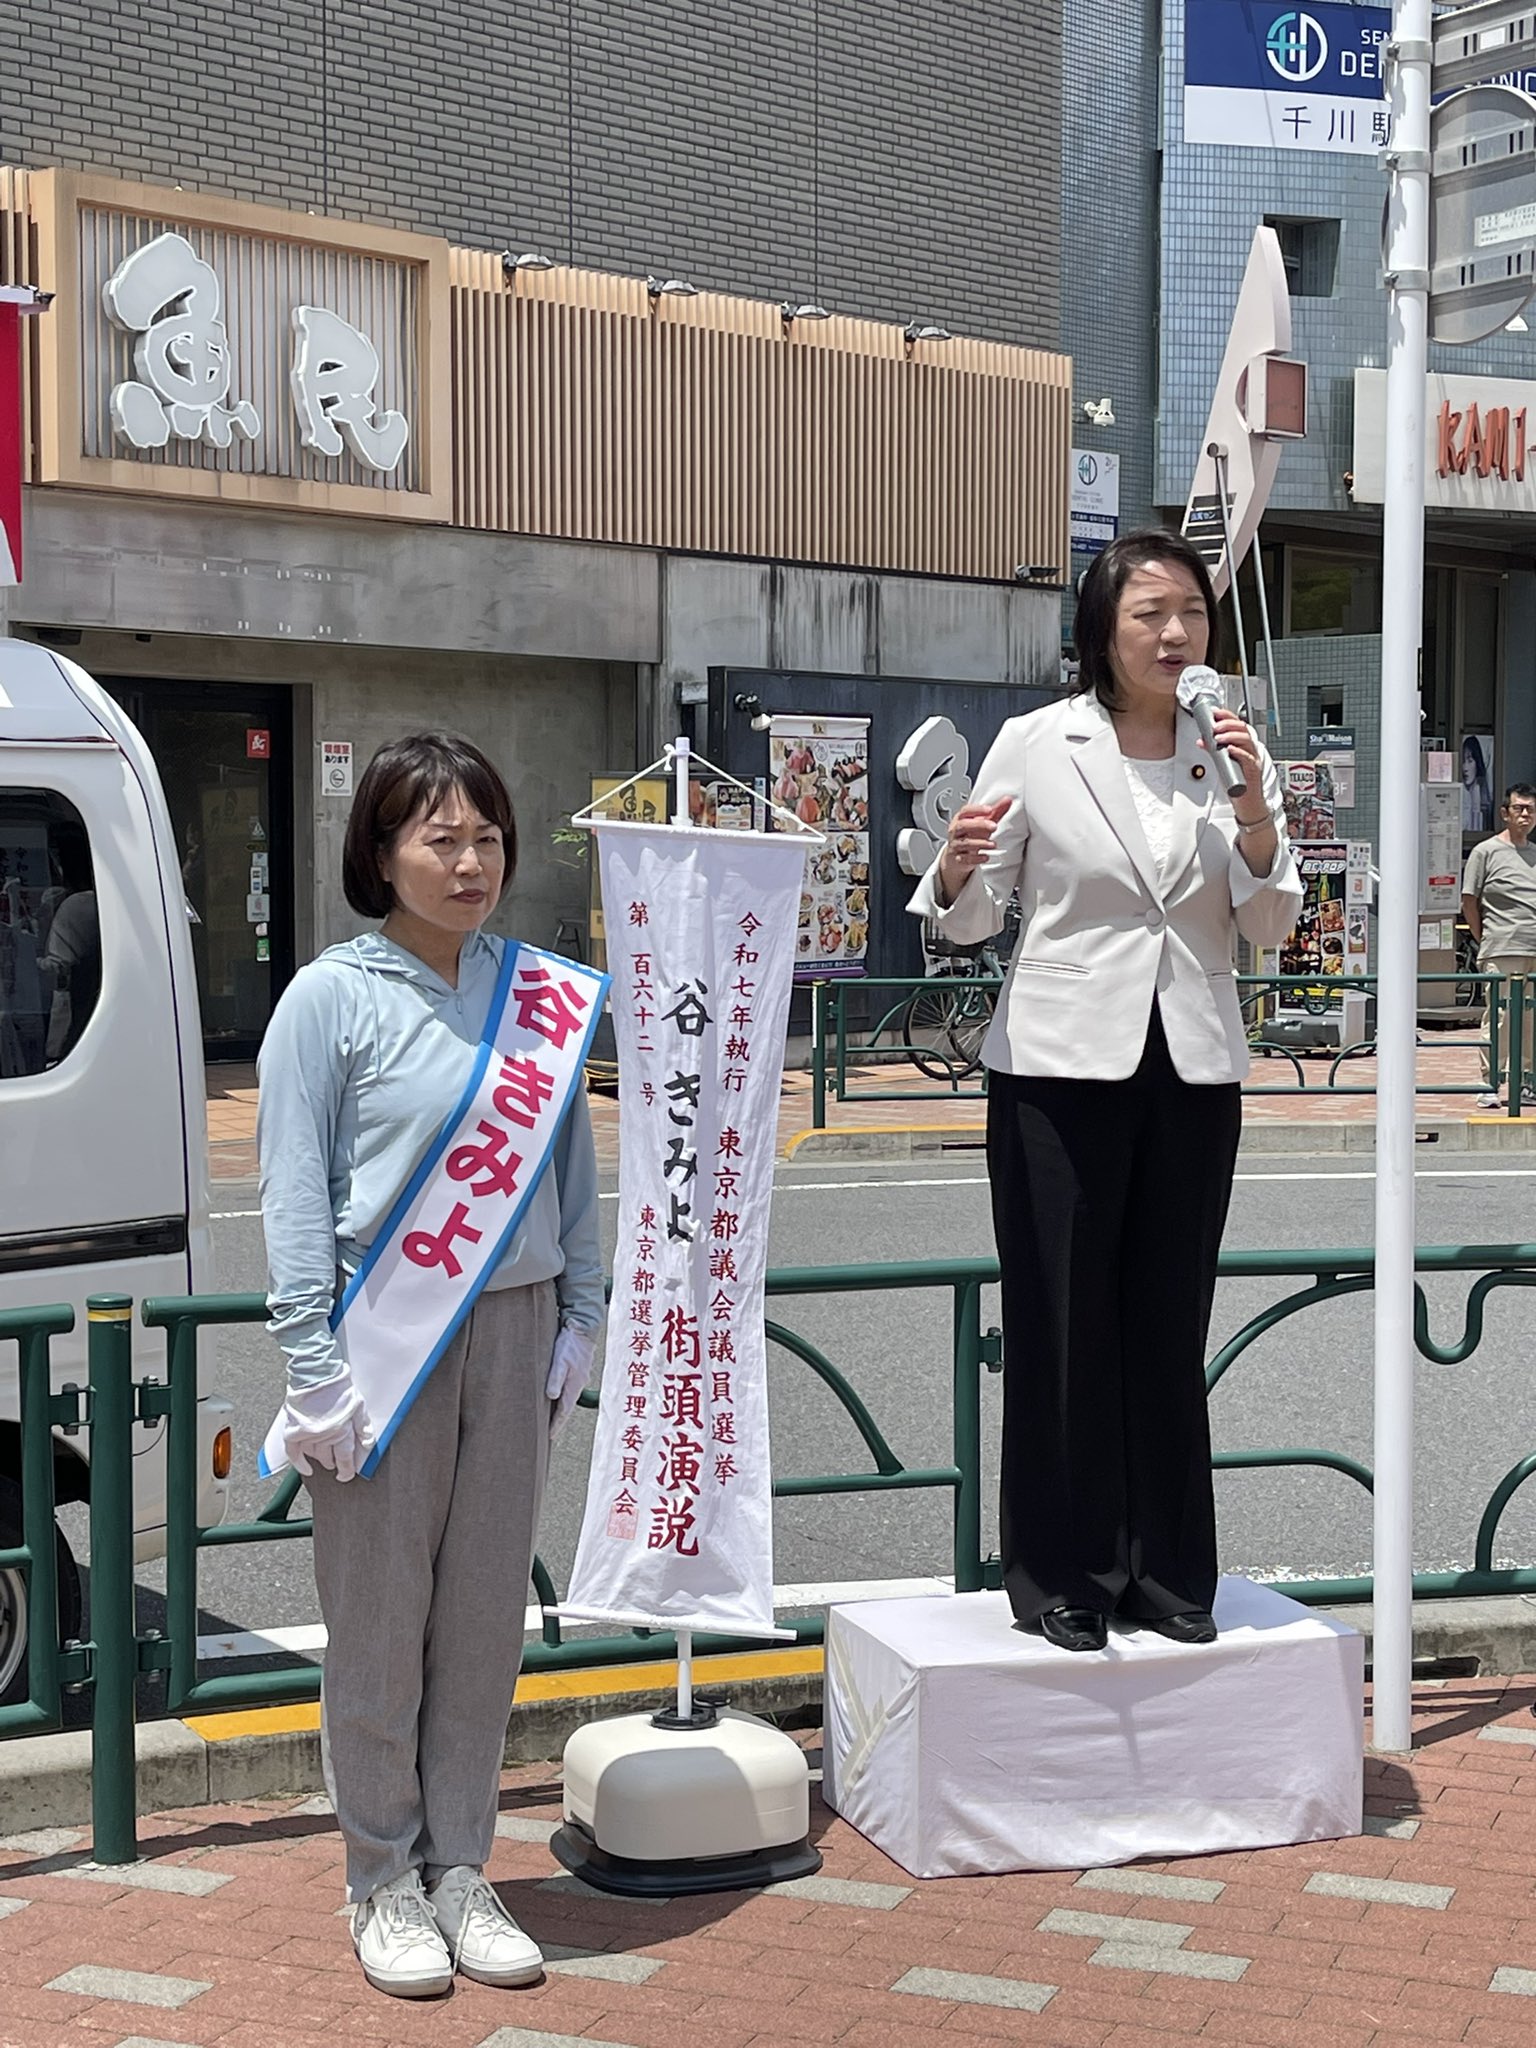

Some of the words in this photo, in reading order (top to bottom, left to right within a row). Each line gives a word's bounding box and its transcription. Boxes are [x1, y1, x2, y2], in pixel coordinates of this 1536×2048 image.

[103, 231, 409, 472] 魚民
[325, 755, 350, 764] あります
[722, 911, 763, 1094] 令和七年執行
[614, 1203, 658, 1516] 東京都選挙管理委員会
[708, 1125, 744, 1487] 東京都議会議員選挙
[647, 1304, 705, 1557] 街頭演説
